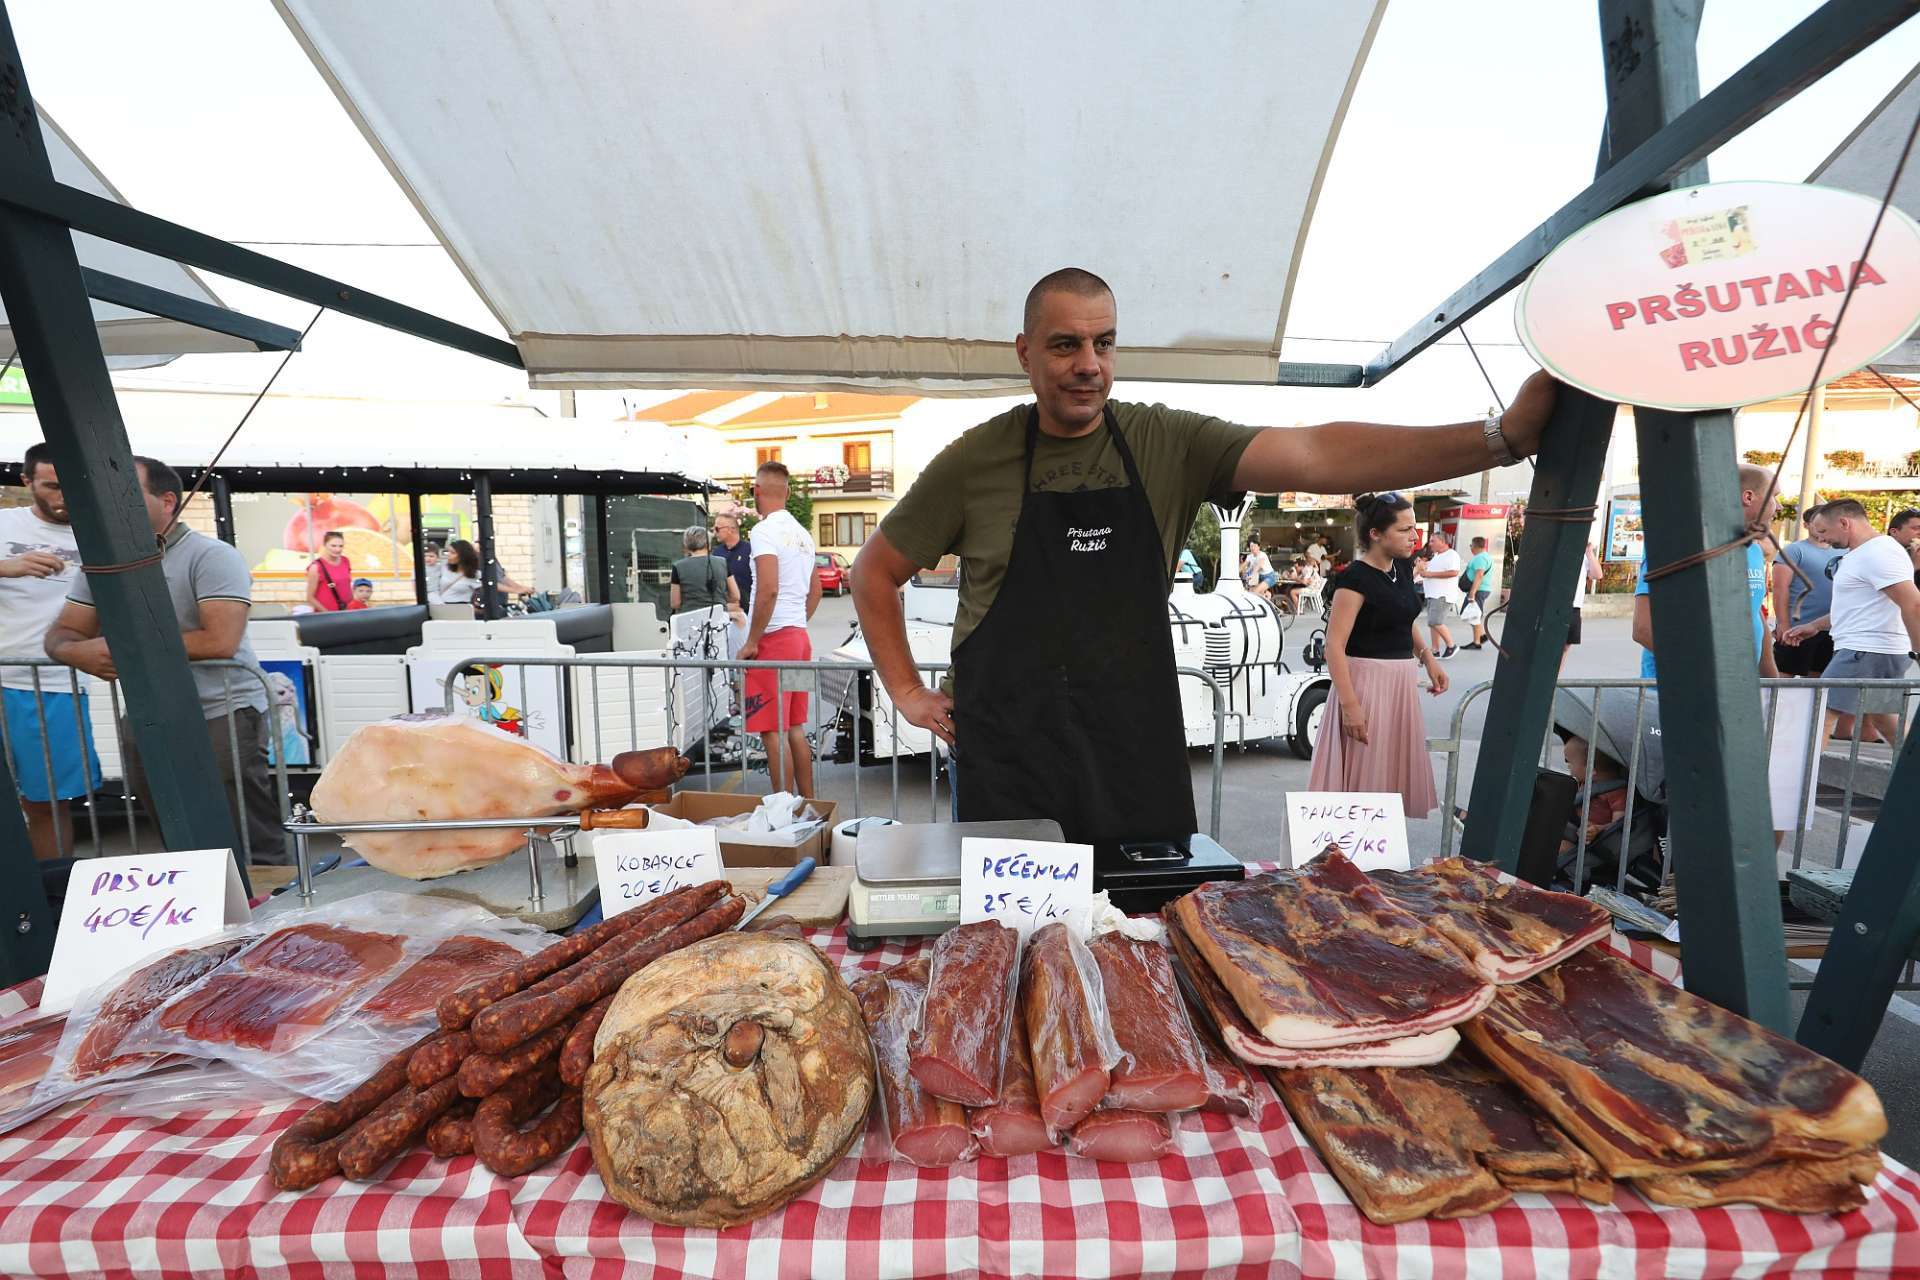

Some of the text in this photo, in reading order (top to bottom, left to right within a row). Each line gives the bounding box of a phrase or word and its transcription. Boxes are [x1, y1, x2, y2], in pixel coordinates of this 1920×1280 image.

[1606, 260, 1887, 331] PRŠUTANA
[1679, 314, 1837, 371] RUŽIĆ
[1032, 461, 1082, 490] HREE
[1066, 526, 1113, 538] Pršutana
[1070, 538, 1107, 552] Ružić
[1300, 805, 1390, 822] PANCETA
[91, 867, 189, 896] PRŠUT
